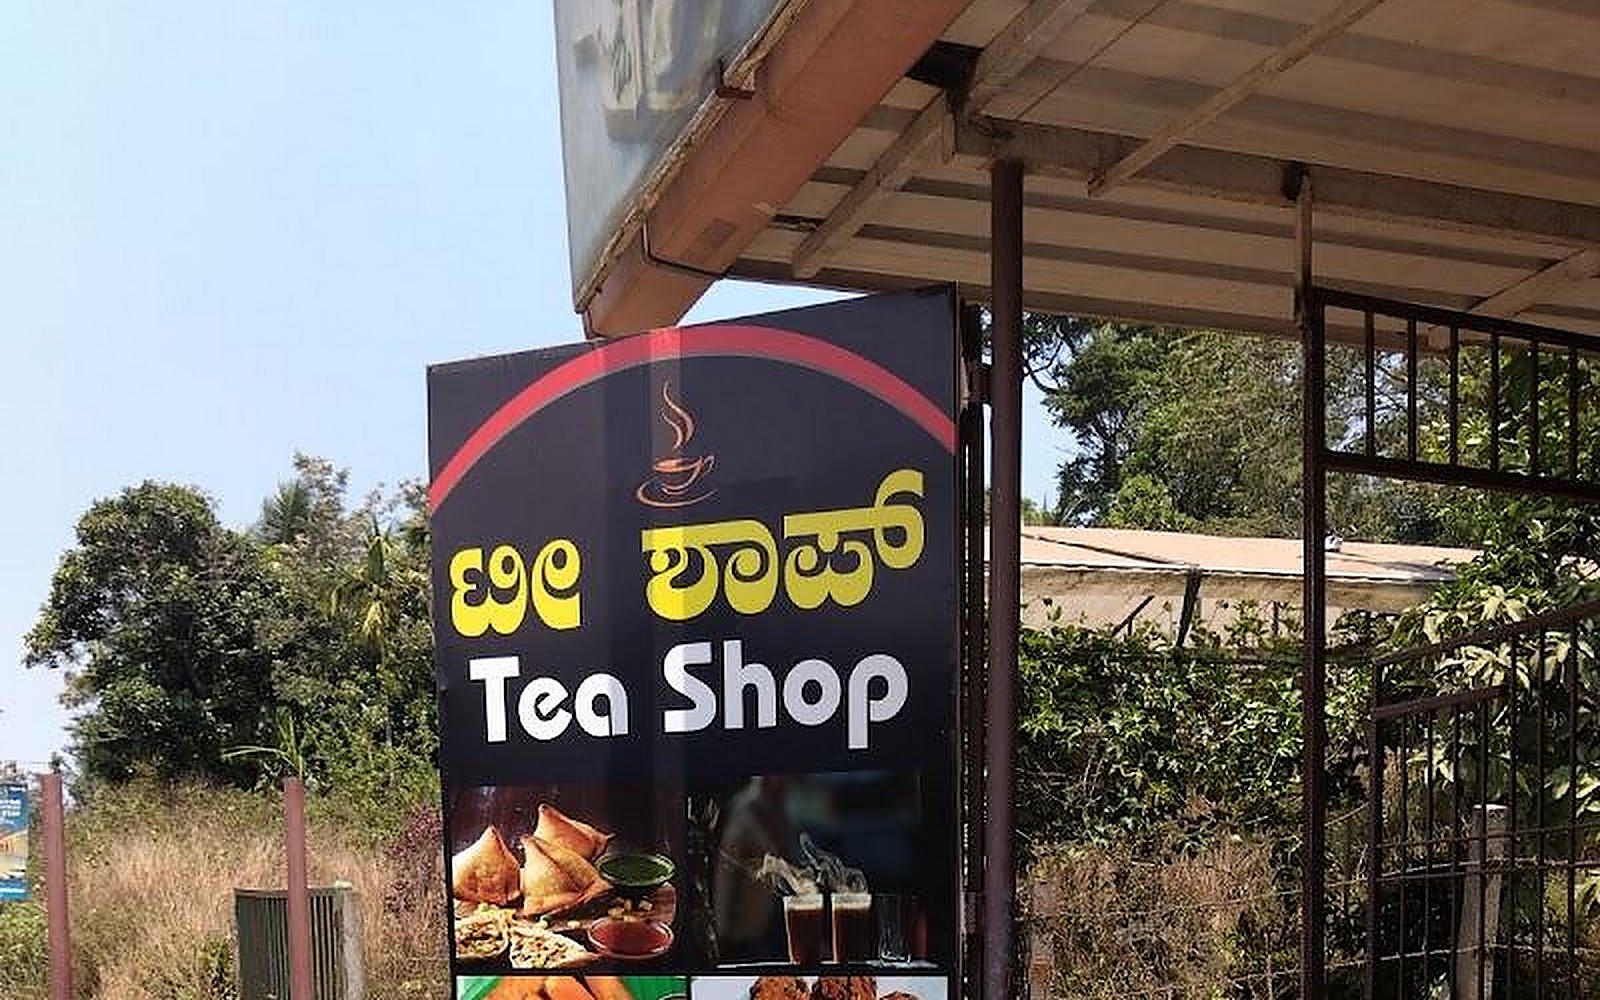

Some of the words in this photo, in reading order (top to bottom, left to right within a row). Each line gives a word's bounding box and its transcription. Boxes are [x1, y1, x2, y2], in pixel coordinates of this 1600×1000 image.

[449, 539, 581, 637] ಟೀ
[641, 469, 924, 621] ಶಾಪ್
[469, 656, 629, 743] Tea
[664, 640, 909, 749] Shop
